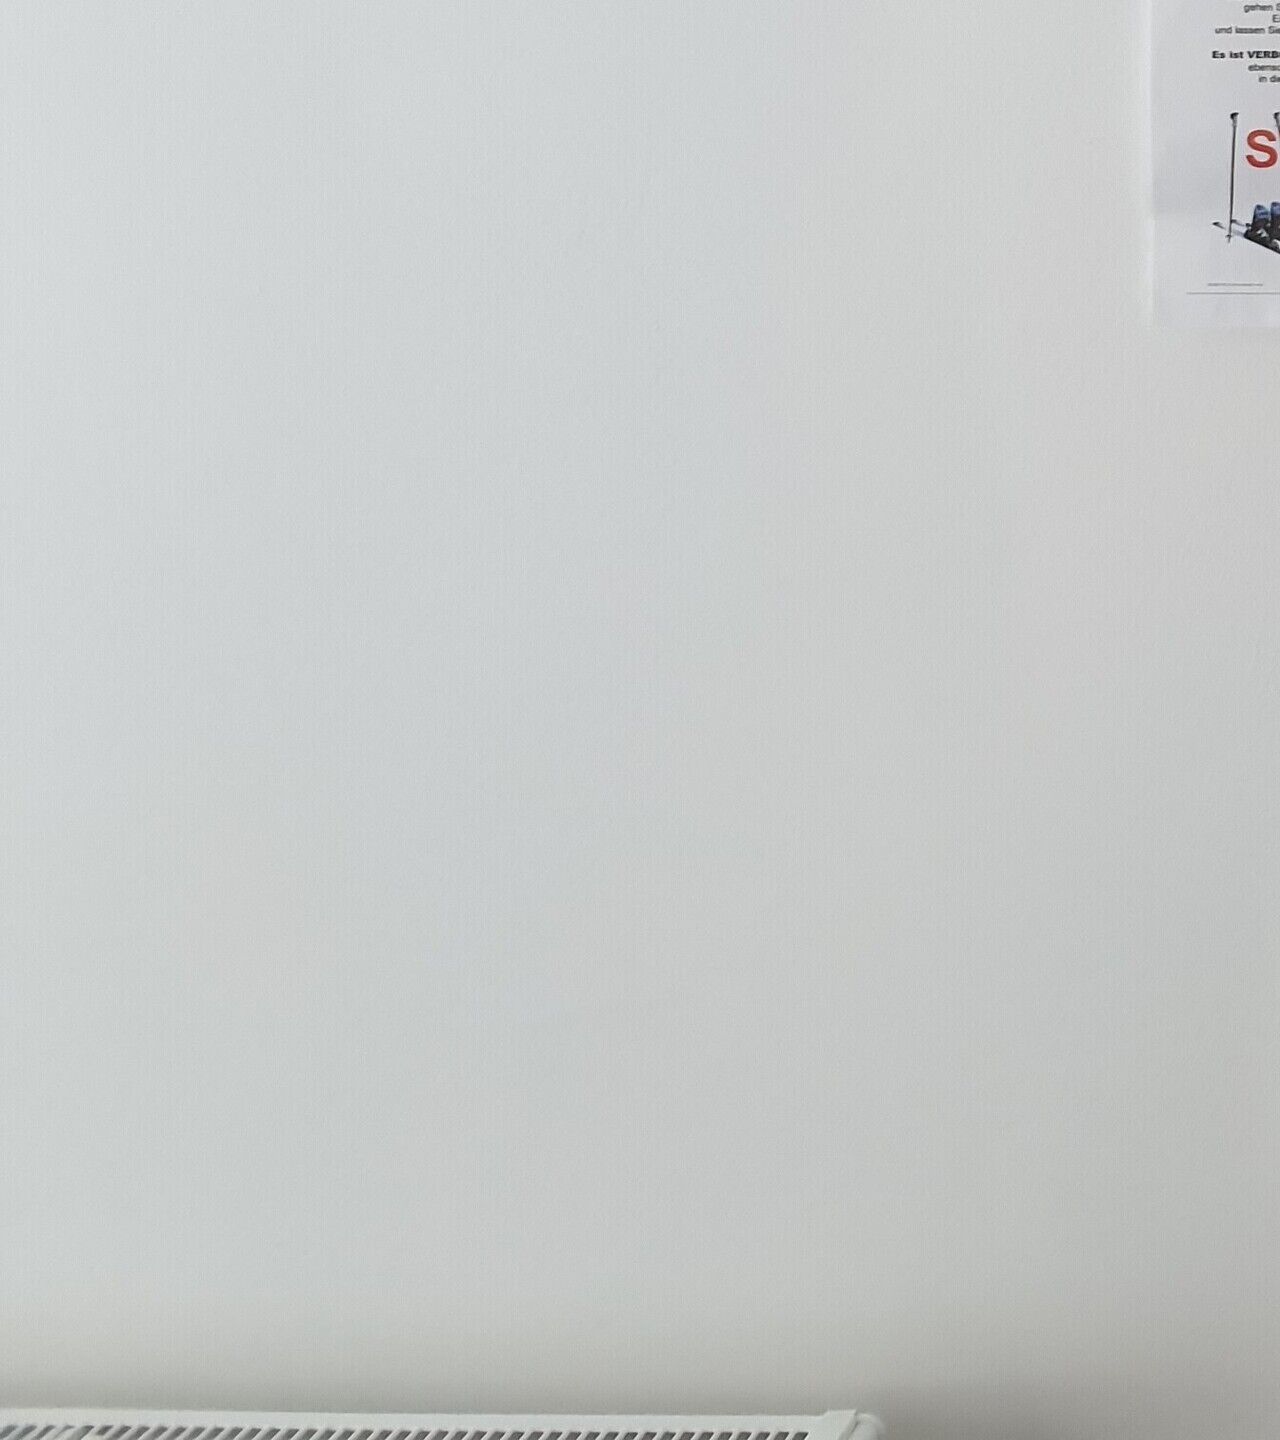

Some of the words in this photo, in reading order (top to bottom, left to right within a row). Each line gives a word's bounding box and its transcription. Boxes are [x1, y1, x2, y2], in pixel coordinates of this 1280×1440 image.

[1243, 3, 1274, 14] gehen
[1214, 25, 1233, 35] und
[1211, 50, 1227, 60] Es
[1228, 50, 1245, 60] ist
[1258, 74, 1268, 83] in
